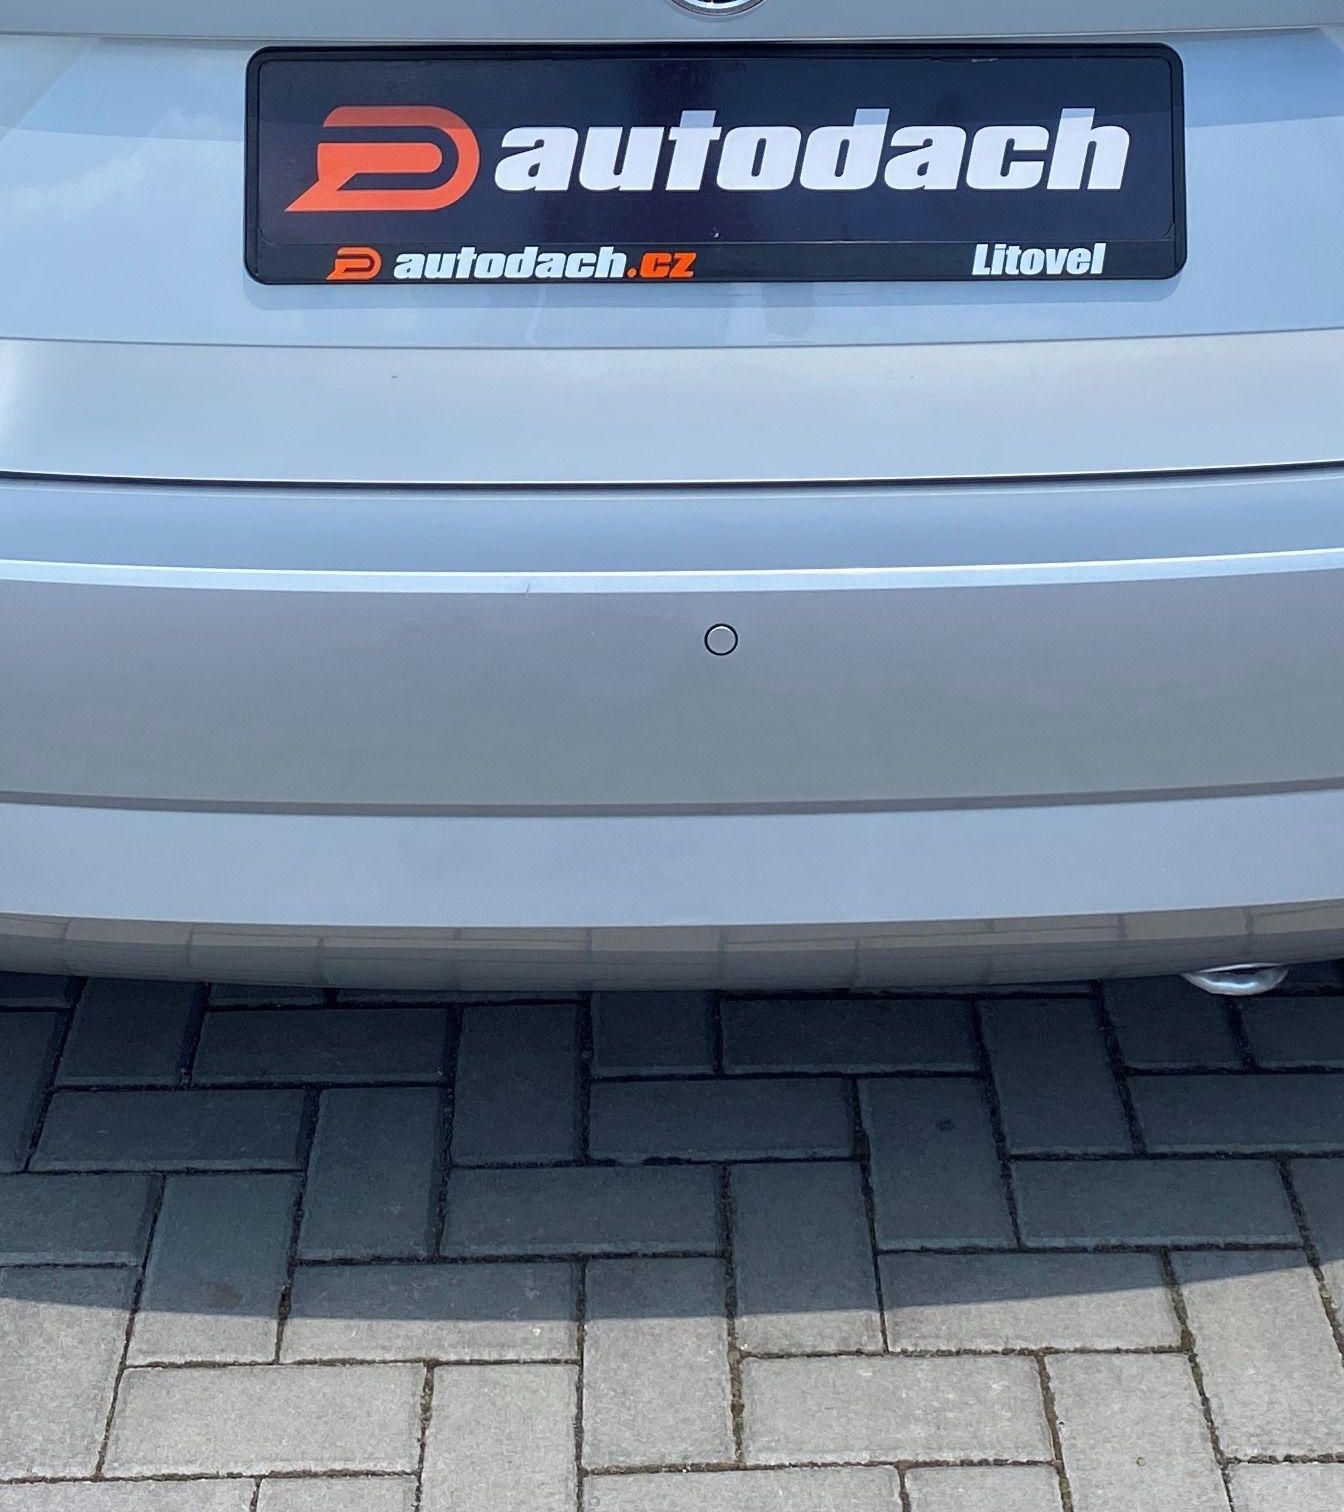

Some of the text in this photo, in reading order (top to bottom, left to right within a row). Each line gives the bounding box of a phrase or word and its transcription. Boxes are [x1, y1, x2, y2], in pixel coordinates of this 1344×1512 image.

[495, 108, 1130, 192] autodach
[394, 245, 694, 280] autodach.cz
[970, 241, 1106, 277] Litovel
